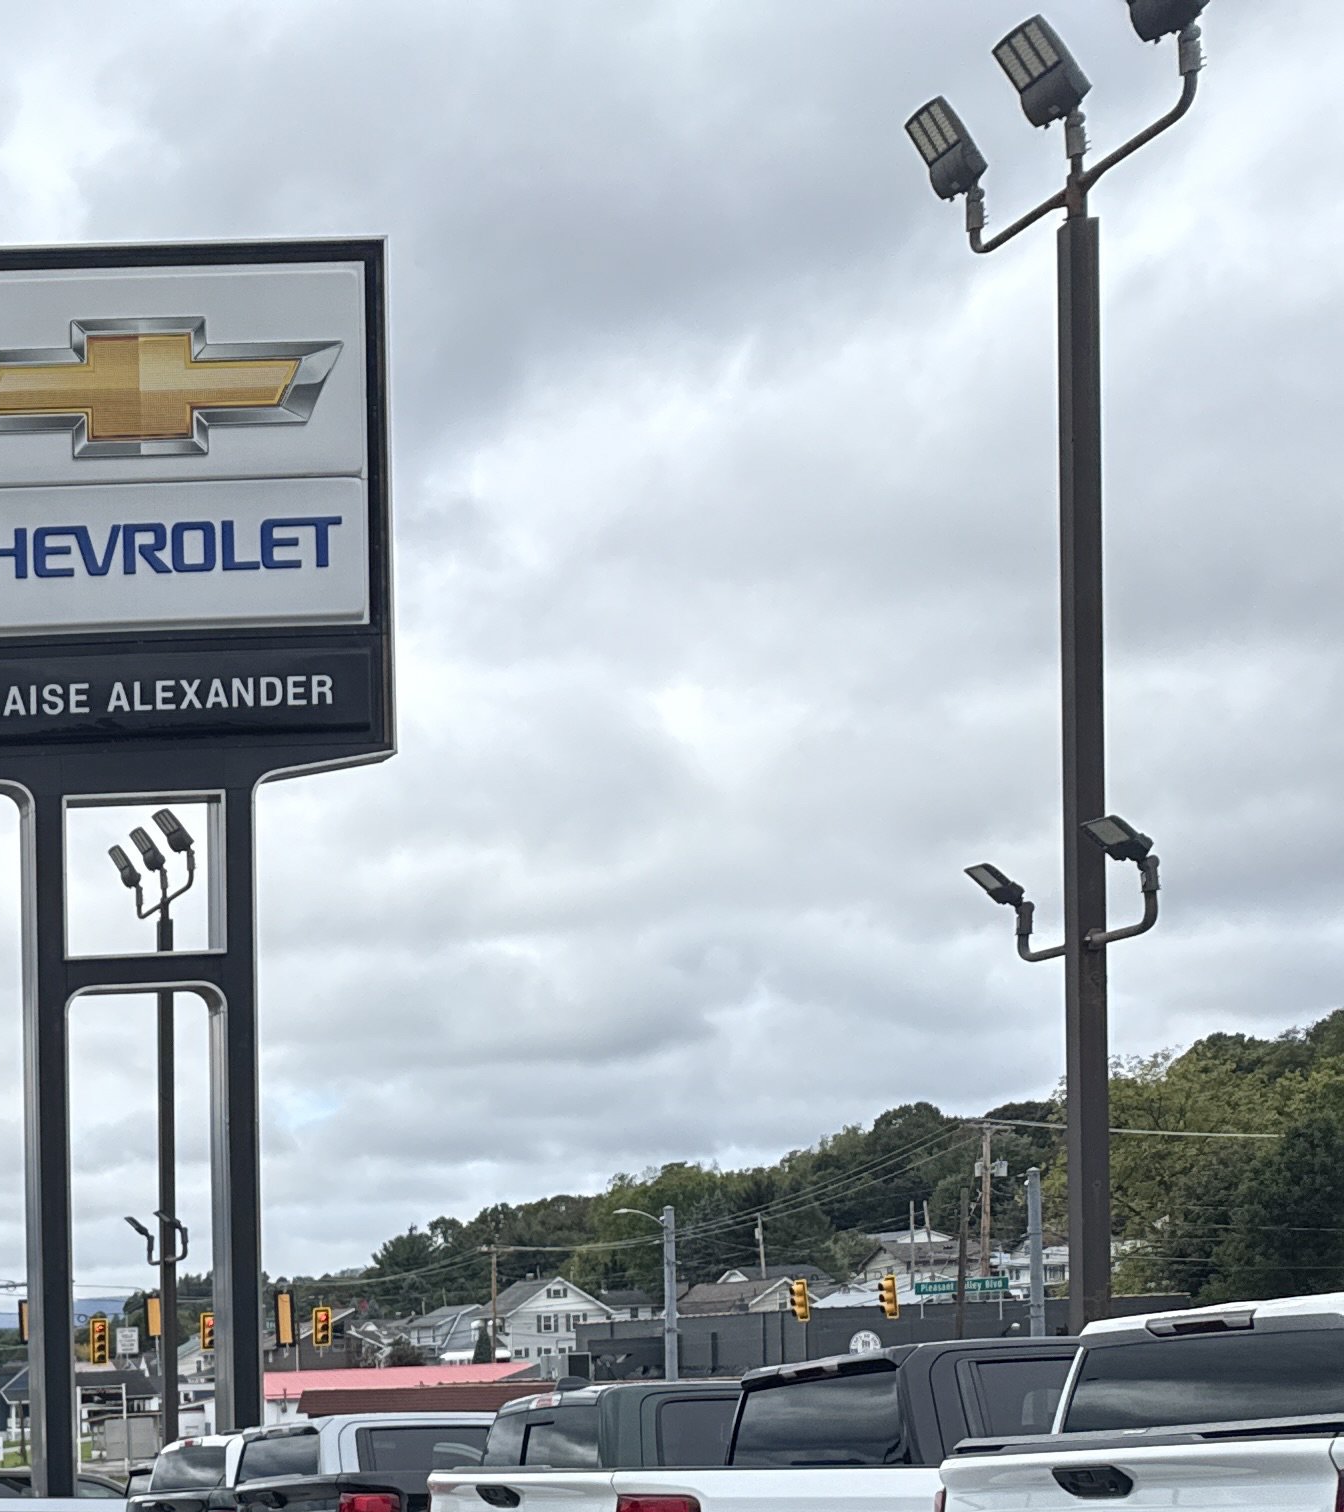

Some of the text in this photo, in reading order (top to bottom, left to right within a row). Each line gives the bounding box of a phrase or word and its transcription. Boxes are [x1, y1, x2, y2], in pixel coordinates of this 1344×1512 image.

[107, 674, 335, 712] ALEXANDER
[920, 1282, 954, 1292] Pleasant
[985, 1280, 1002, 1289] Blvd
